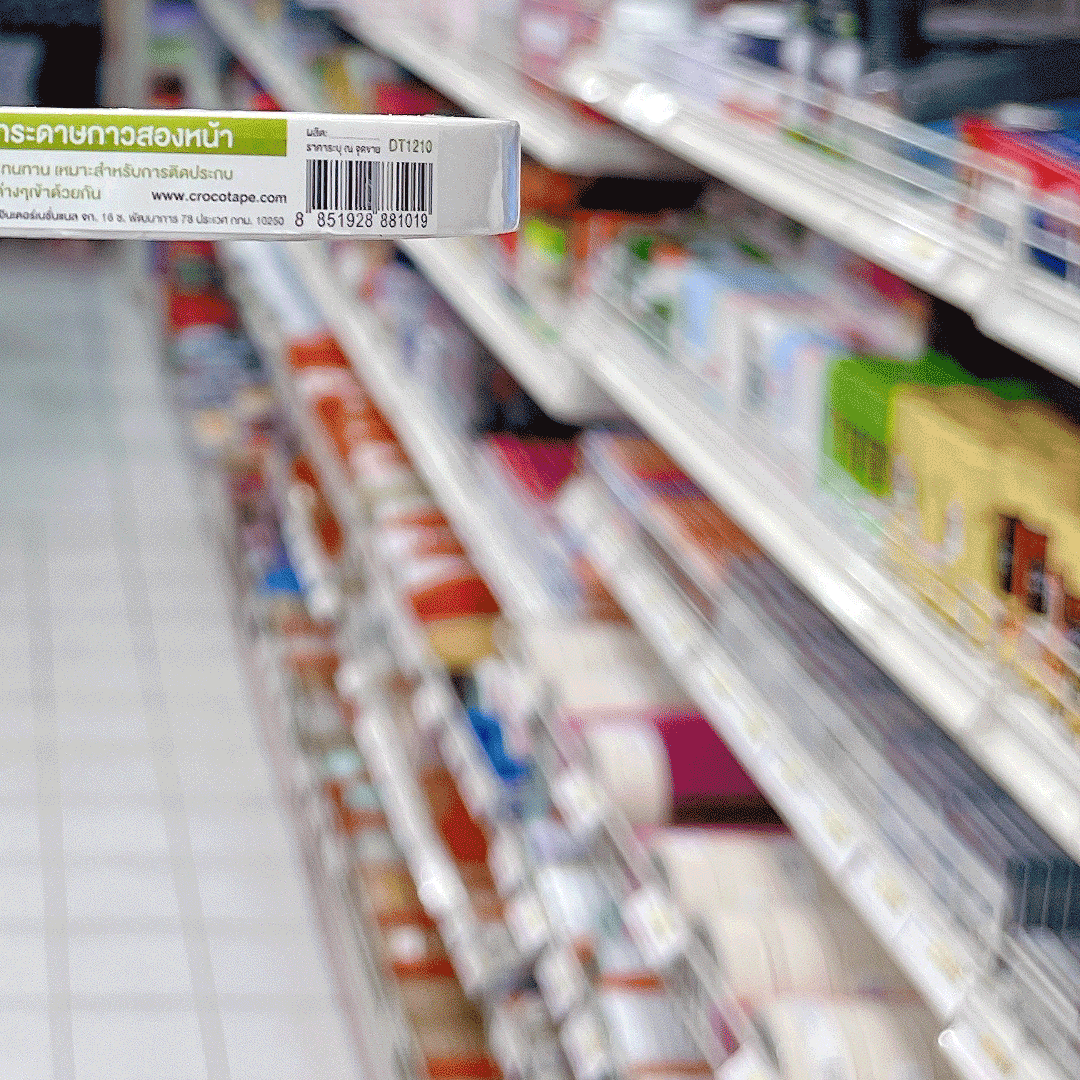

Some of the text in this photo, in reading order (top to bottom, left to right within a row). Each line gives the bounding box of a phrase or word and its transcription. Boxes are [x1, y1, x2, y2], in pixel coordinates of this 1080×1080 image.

[389, 138, 433, 154] DT1210
[152, 191, 288, 205] www.crocotape.com
[294, 212, 428, 228] 8 851928 881019
